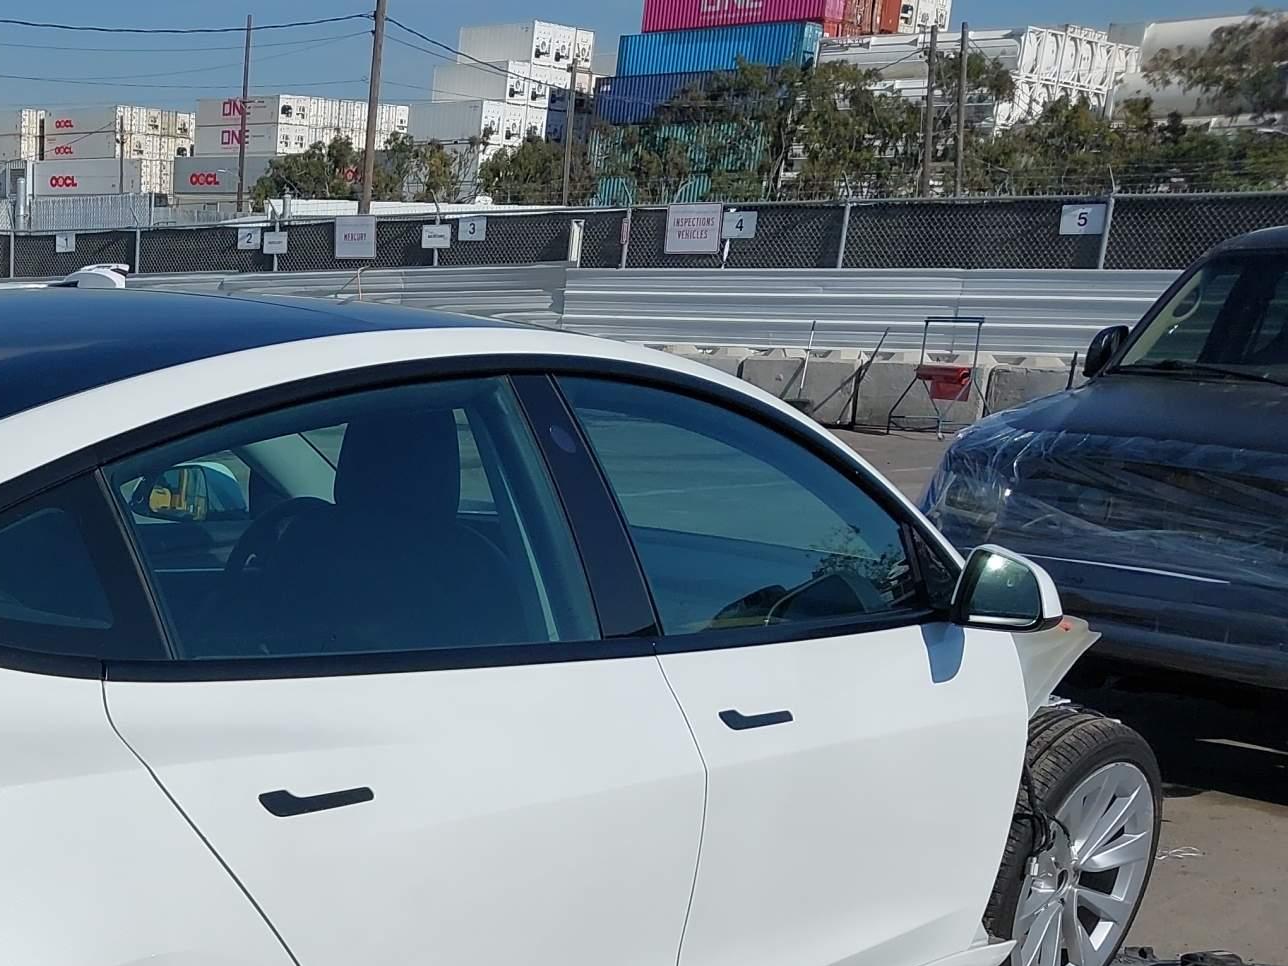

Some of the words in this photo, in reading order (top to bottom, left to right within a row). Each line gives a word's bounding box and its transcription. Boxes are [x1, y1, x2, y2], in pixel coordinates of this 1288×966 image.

[55, 120, 74, 129] OOCL
[54, 145, 74, 155] OOCL
[49, 175, 78, 188] OOCL
[189, 172, 220, 186] OOCL
[735, 218, 744, 232] 4
[1077, 212, 1088, 227] 5
[468, 222, 476, 235] 3
[677, 229, 708, 240] VEHICLES
[246, 232, 253, 243] 2
